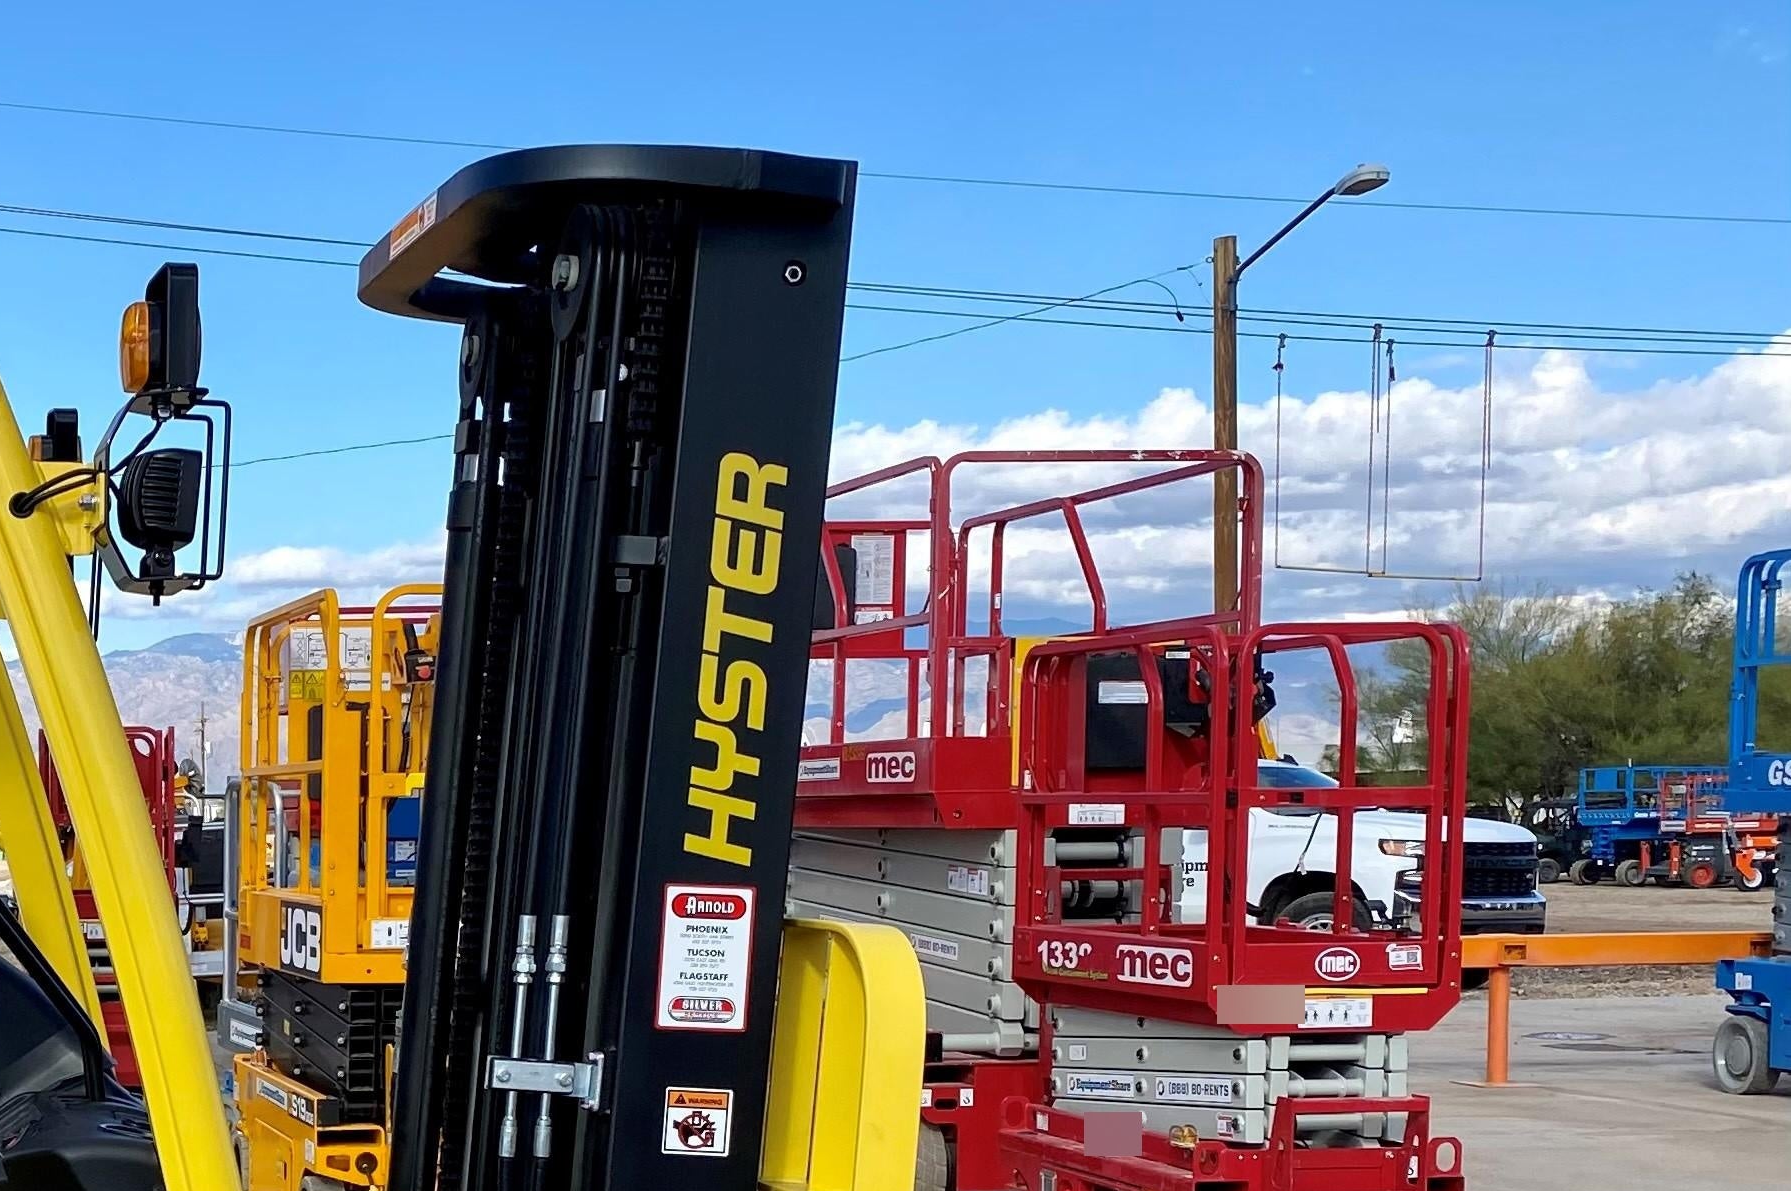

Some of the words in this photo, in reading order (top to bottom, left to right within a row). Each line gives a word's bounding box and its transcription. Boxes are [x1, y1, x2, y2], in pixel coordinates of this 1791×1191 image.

[683, 451, 790, 868] HYSTER
[868, 755, 914, 779] mec
[685, 896, 735, 915] ARNOLD
[685, 924, 729, 934] PHOENIX
[281, 907, 322, 973] JCB
[686, 948, 726, 958] TUCSON
[1118, 948, 1192, 983] mec
[679, 971, 729, 981] FLAGSTAFF
[681, 998, 723, 1011] SILVER
[1075, 1078, 1132, 1093] EquipmentShare
[1168, 1081, 1190, 1096] (888)
[1191, 1084, 1229, 1097] 80-RENTS
